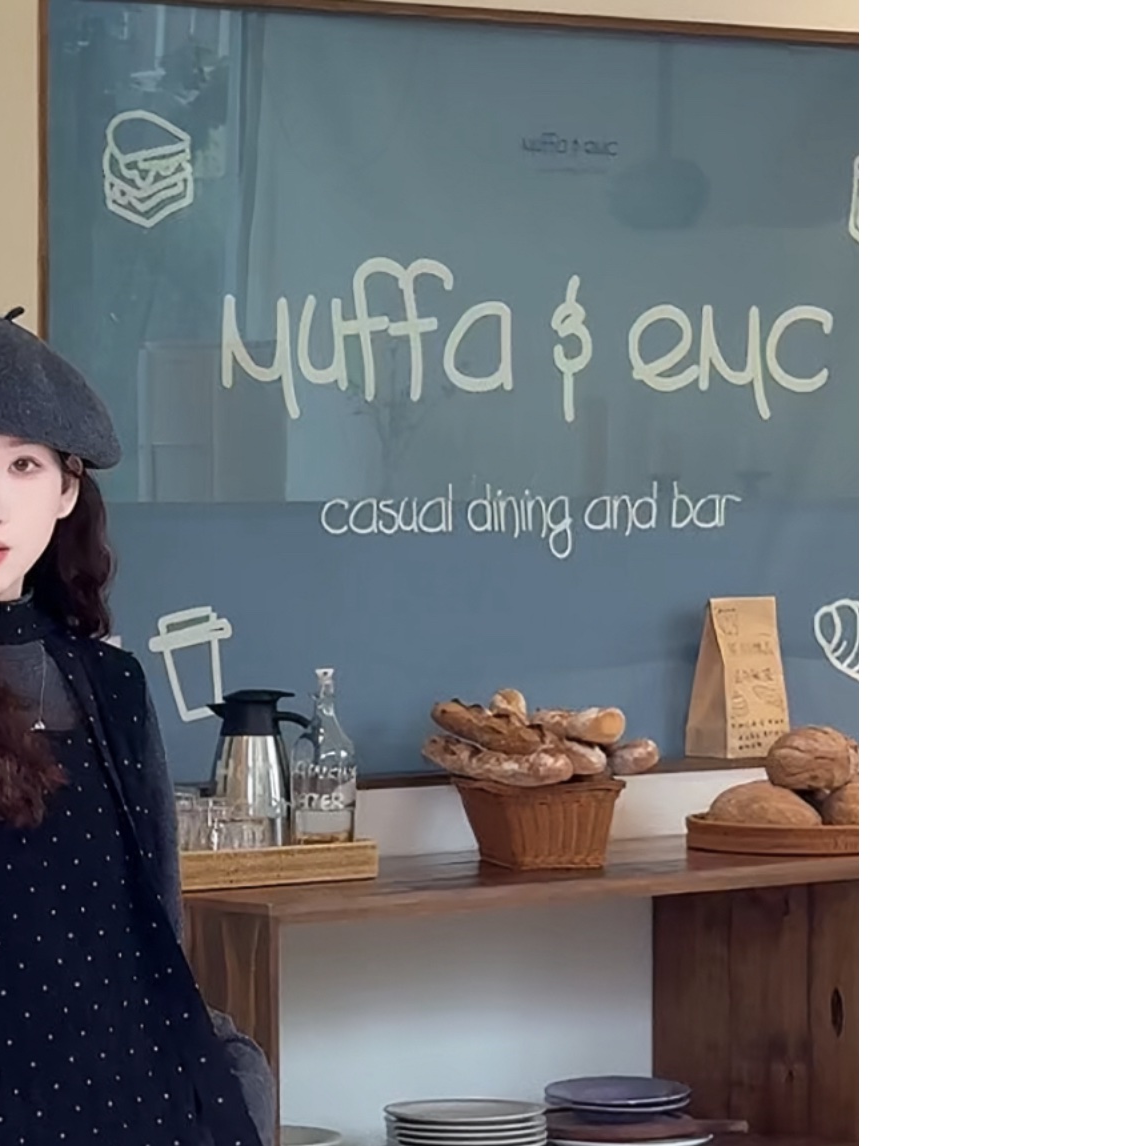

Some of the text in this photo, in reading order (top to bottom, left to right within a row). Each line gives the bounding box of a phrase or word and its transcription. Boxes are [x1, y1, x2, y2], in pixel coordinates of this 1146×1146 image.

[221, 257, 514, 421] Muffa
[550, 274, 593, 423] &
[320, 480, 742, 560] casual dining and bar
